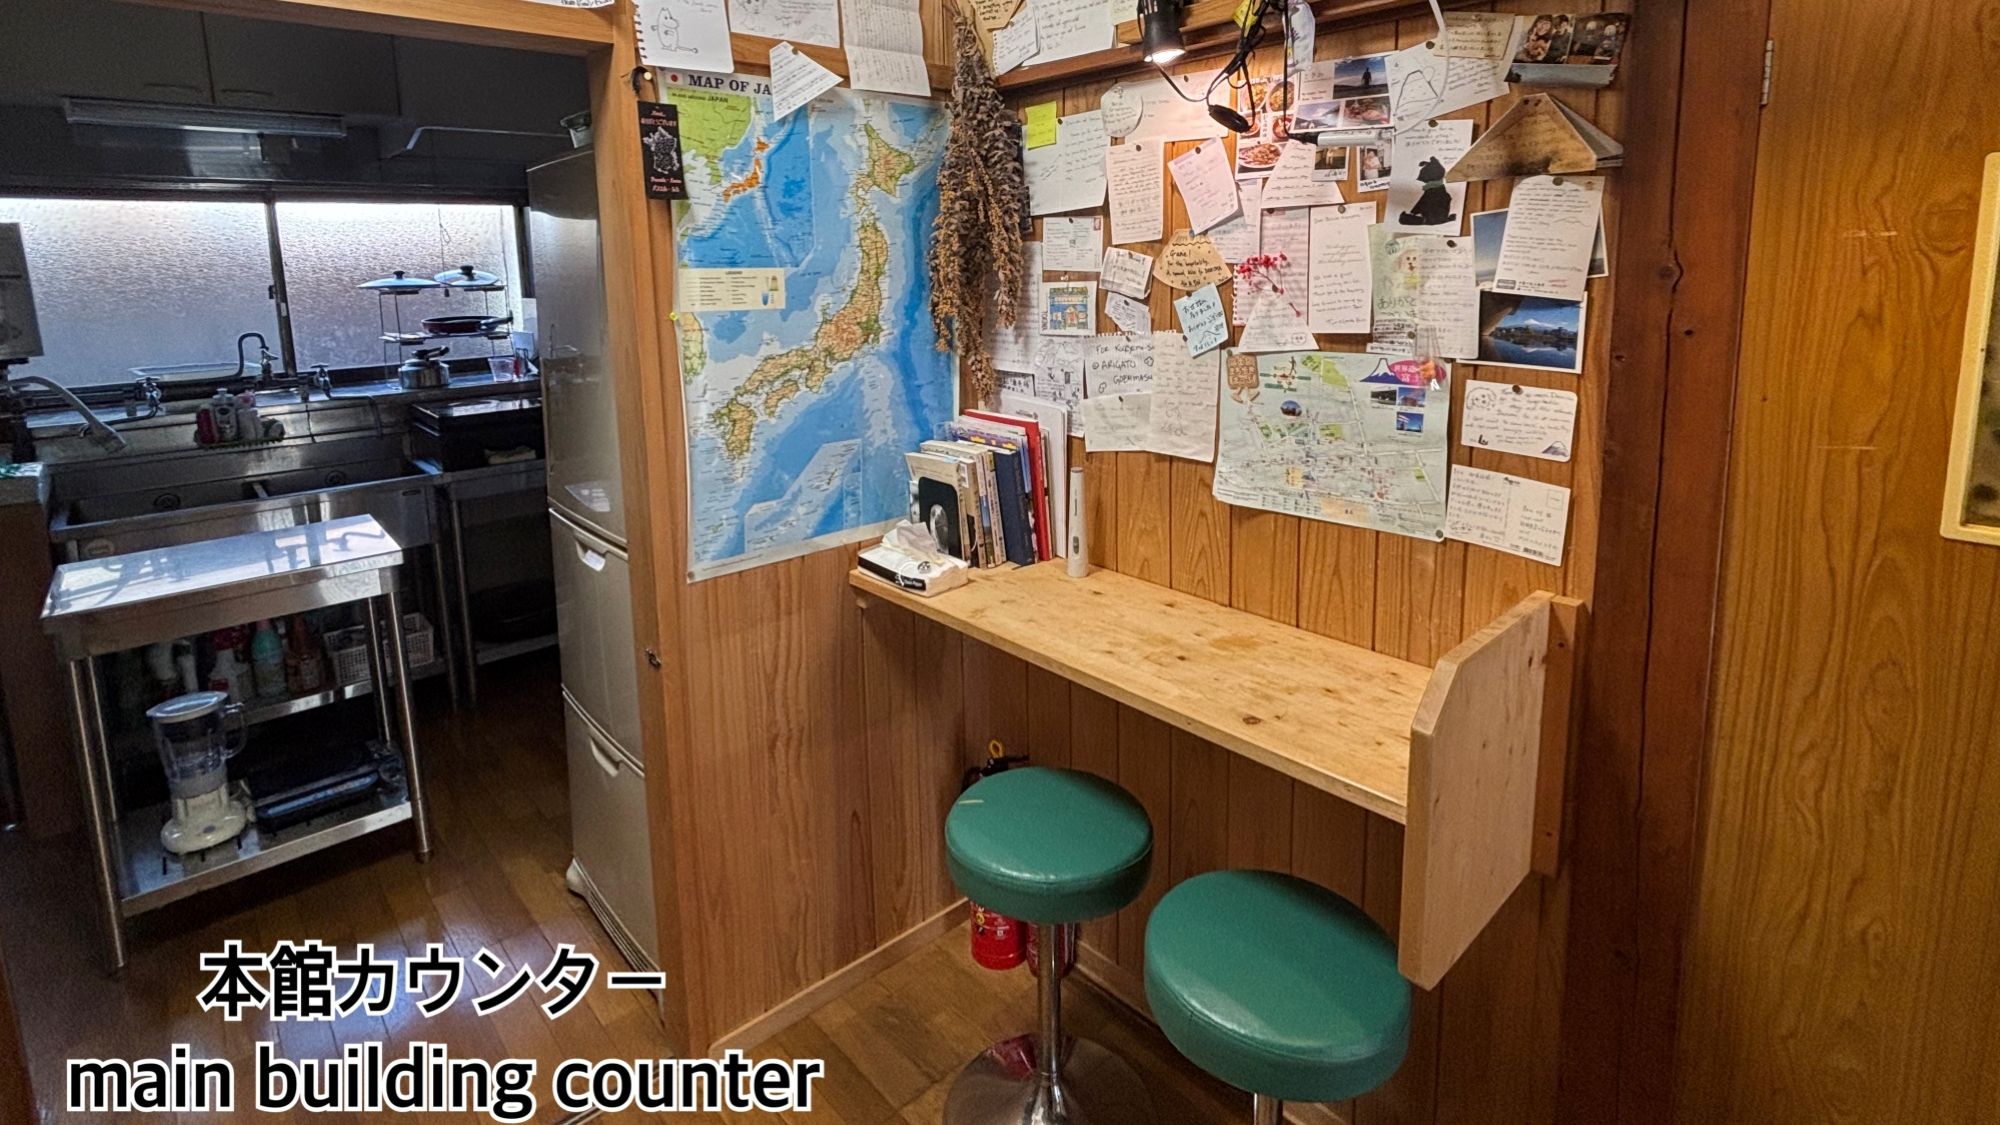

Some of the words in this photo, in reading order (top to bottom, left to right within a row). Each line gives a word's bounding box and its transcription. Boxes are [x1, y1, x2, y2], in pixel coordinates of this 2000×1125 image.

[688, 75, 725, 89] MAP
[729, 79, 750, 92] OF
[707, 94, 729, 103] JAPAN
[1101, 360, 1136, 373] ARIGATO
